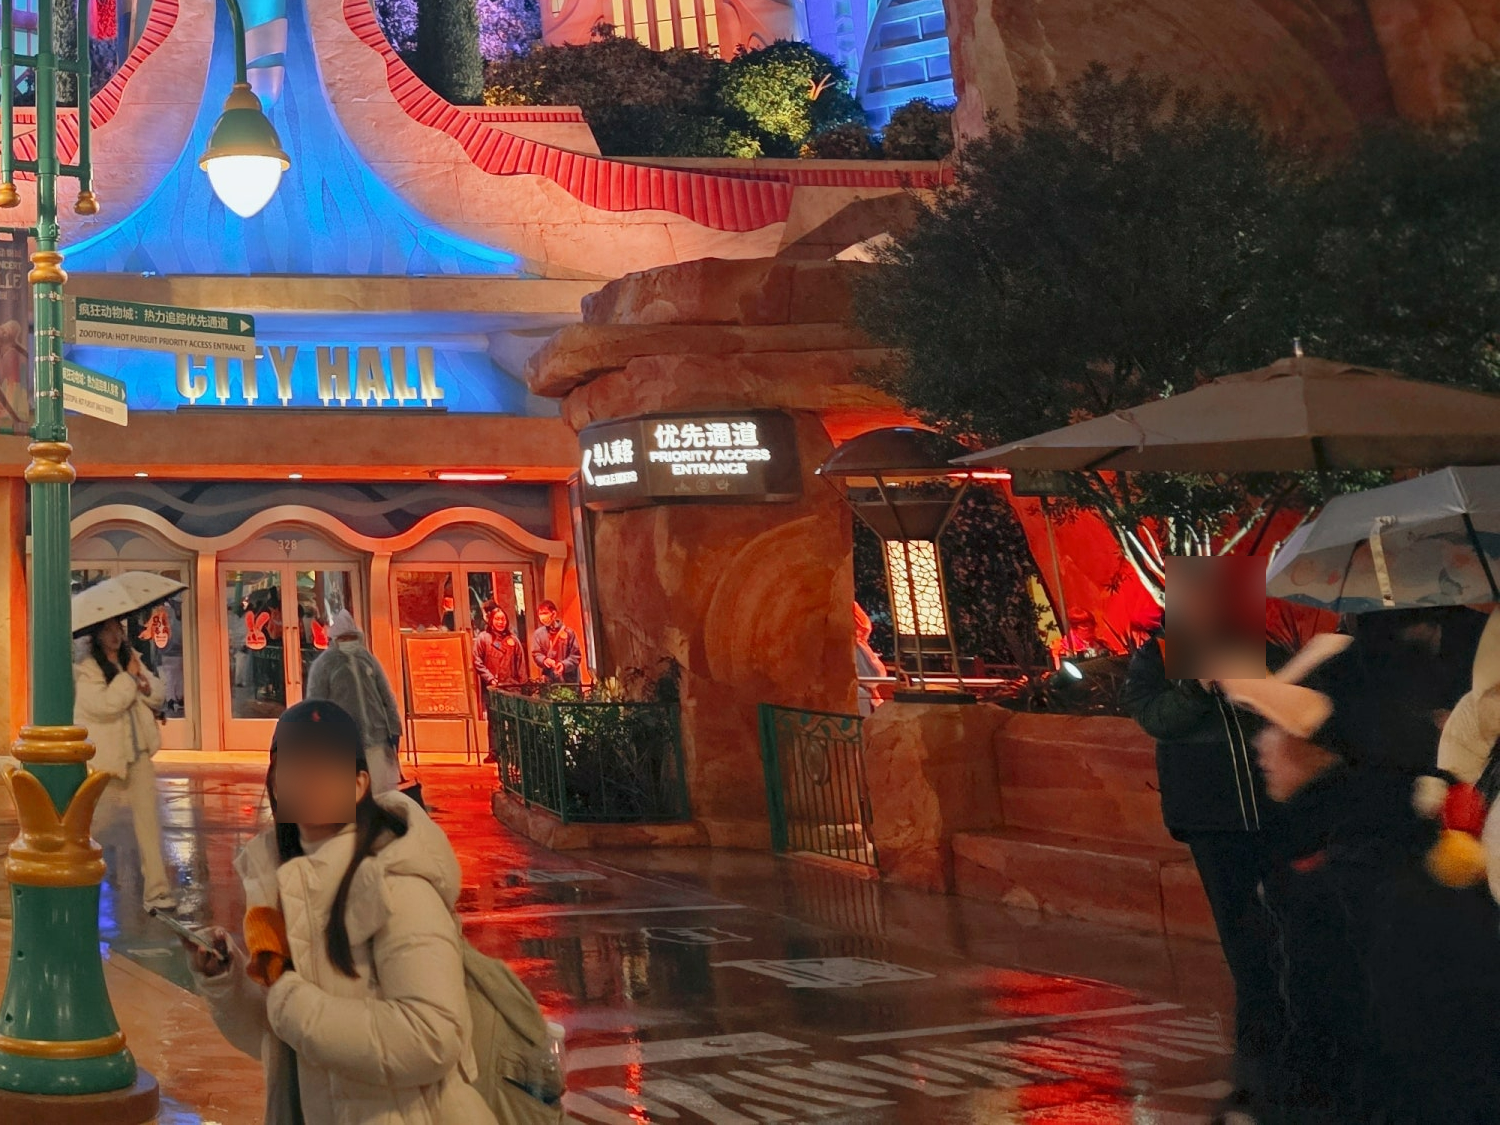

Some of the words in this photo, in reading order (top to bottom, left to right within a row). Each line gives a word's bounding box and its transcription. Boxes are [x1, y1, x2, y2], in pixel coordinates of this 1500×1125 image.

[79, 329, 115, 341] ZOOTOPIA:
[116, 333, 129, 341] HOT
[130, 334, 158, 345] PURSUIT
[159, 337, 188, 347] PRIORITY
[189, 339, 213, 350] ACCESS
[213, 341, 246, 352] ENTRANCE
[177, 347, 298, 399] CITY
[315, 346, 445, 400] HALL
[654, 422, 759, 449] 优先通道
[593, 438, 634, 467] 单人乘客
[649, 450, 712, 463] PRIORITY
[714, 448, 771, 461] ACCESS
[671, 462, 748, 475] ENTRANCE
[278, 539, 298, 550] 328
